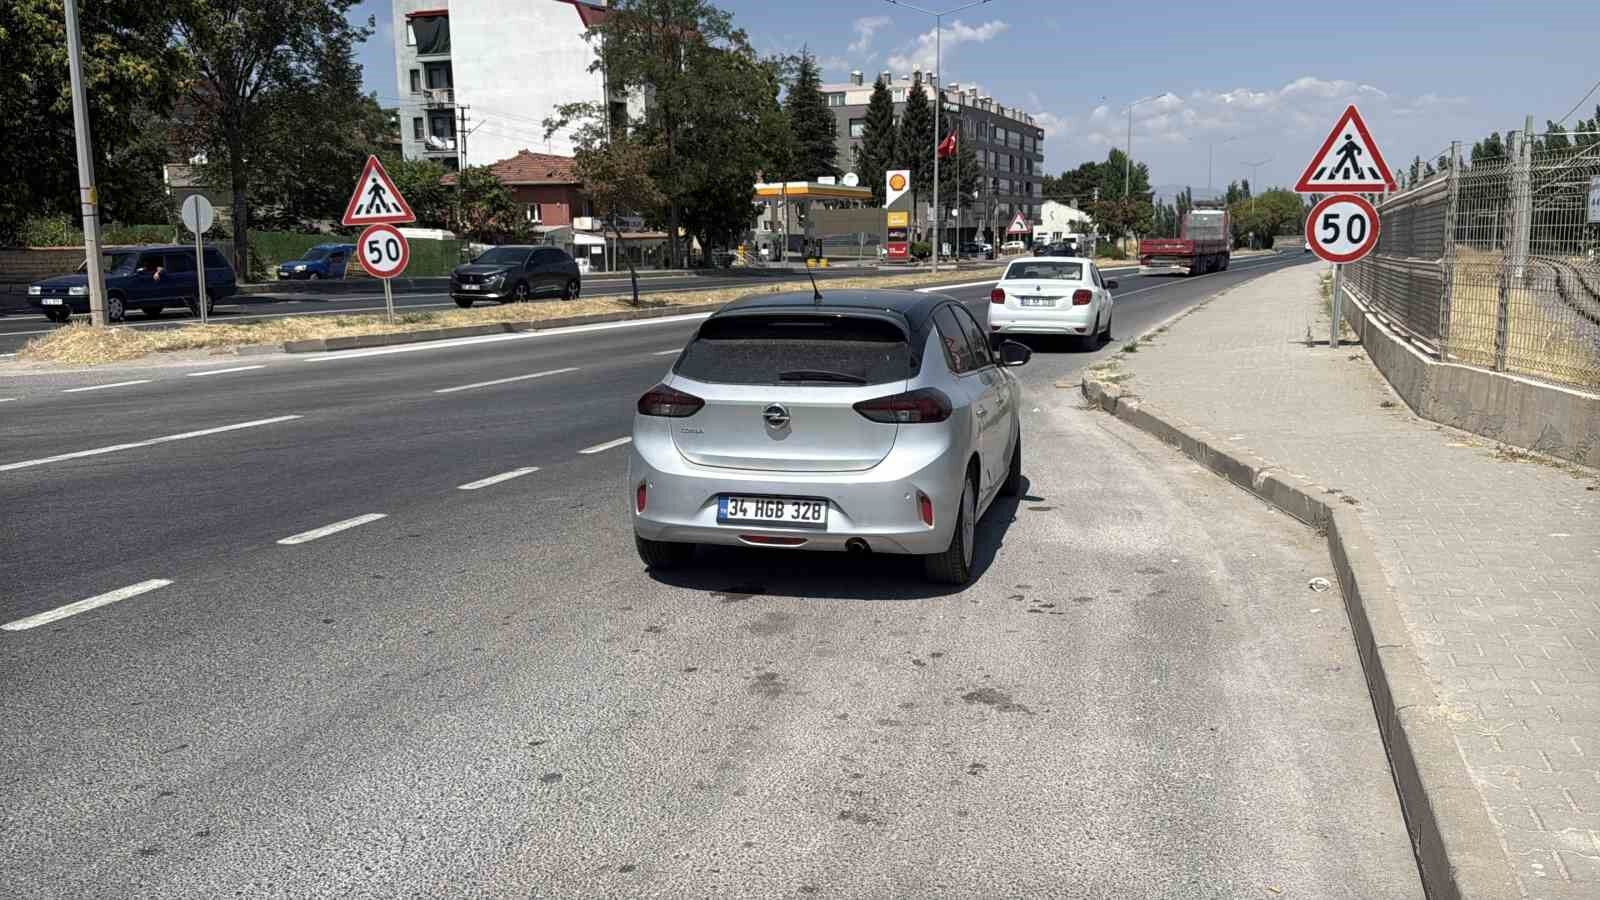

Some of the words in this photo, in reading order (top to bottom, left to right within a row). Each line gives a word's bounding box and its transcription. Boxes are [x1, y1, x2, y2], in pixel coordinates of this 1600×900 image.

[1321, 213, 1366, 244] 50
[368, 238, 400, 264] 50
[729, 499, 748, 516] 34
[755, 500, 784, 518] HGB
[791, 502, 821, 520] 328
